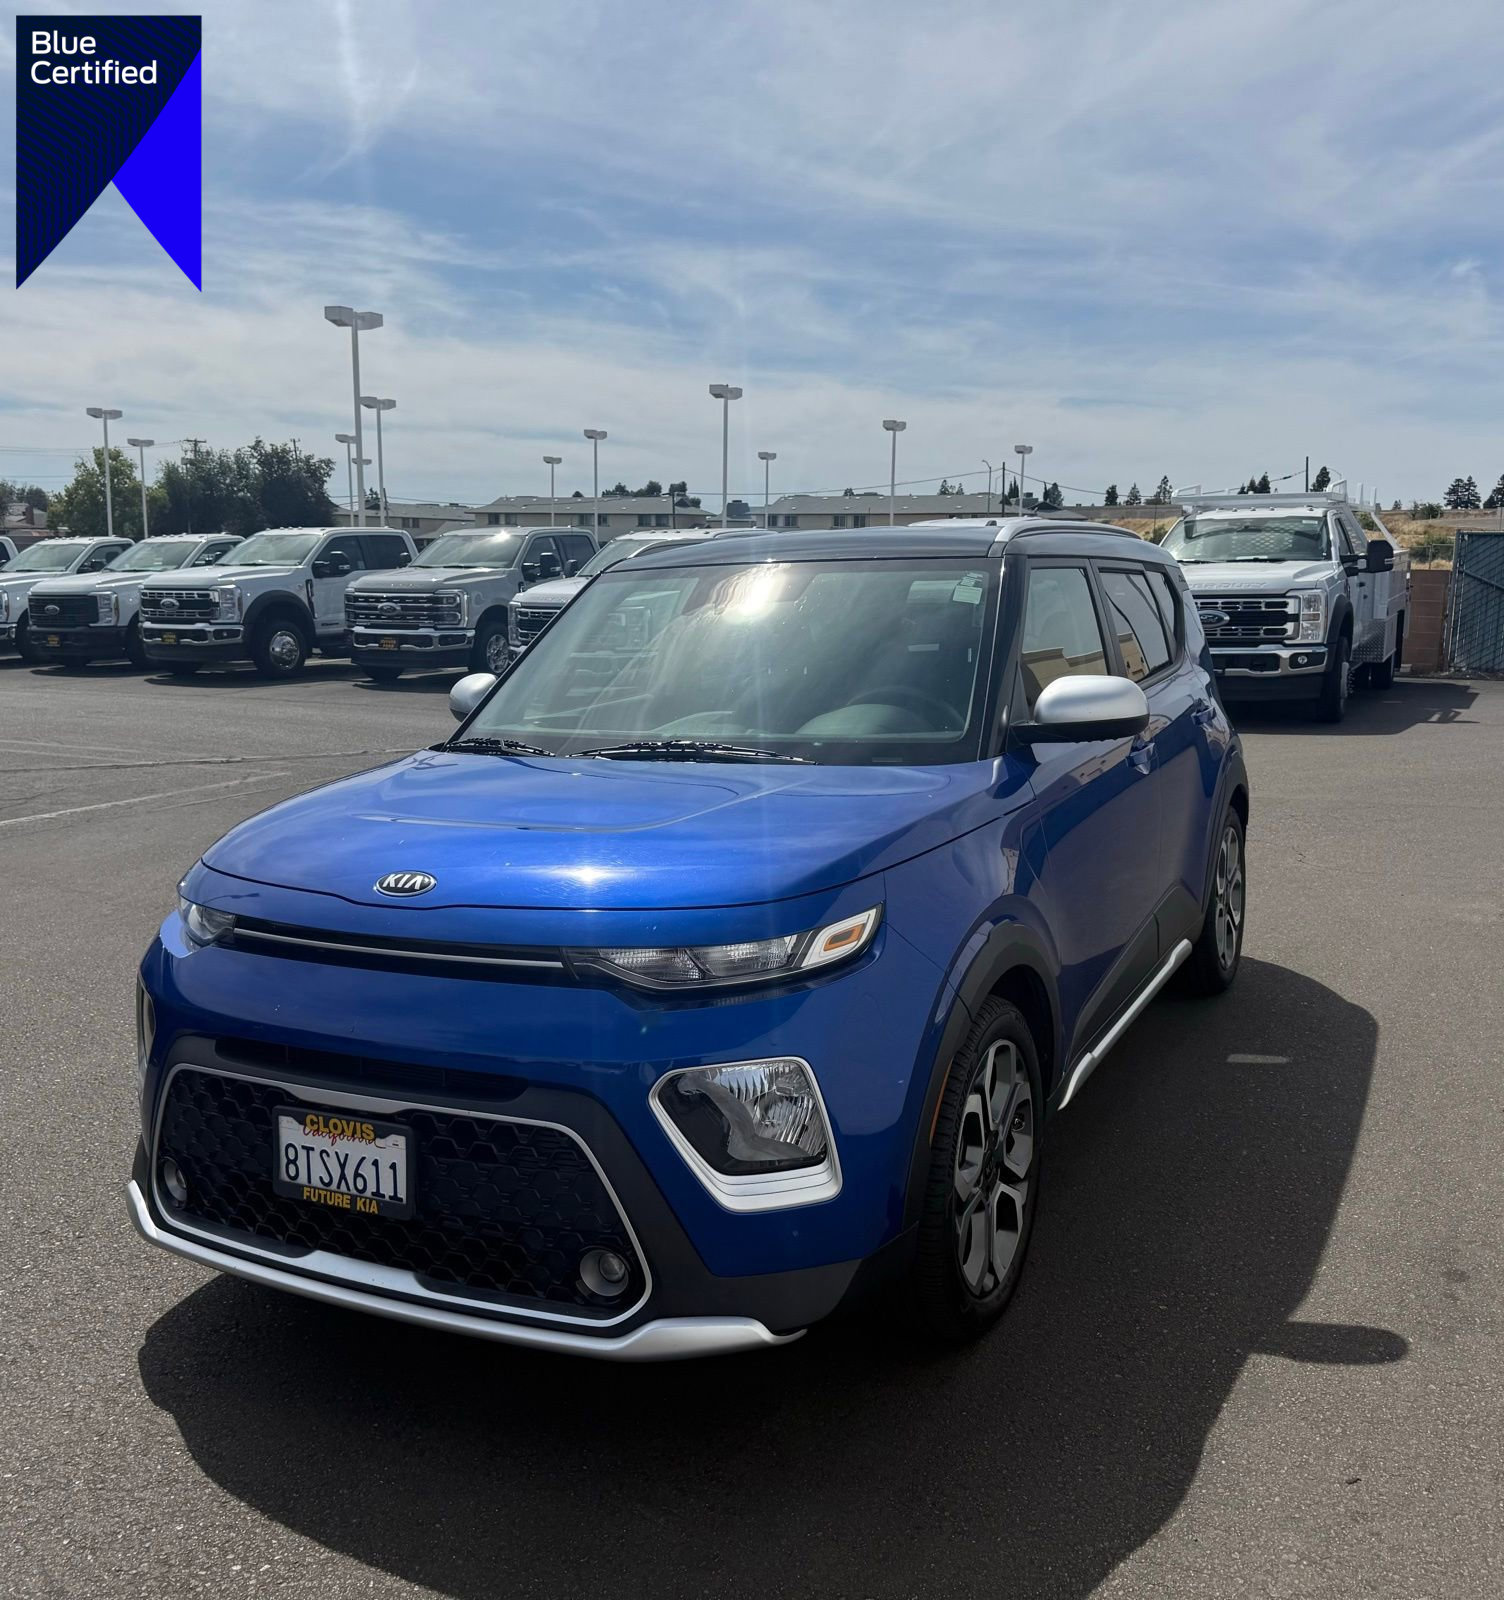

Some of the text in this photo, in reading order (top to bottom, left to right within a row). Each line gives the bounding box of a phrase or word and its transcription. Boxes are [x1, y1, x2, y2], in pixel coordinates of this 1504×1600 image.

[382, 873, 424, 890] KIA
[305, 1113, 376, 1141] CLOVIS
[284, 1142, 404, 1203] 8TSX611
[303, 1186, 379, 1215] FUTURE KIA
